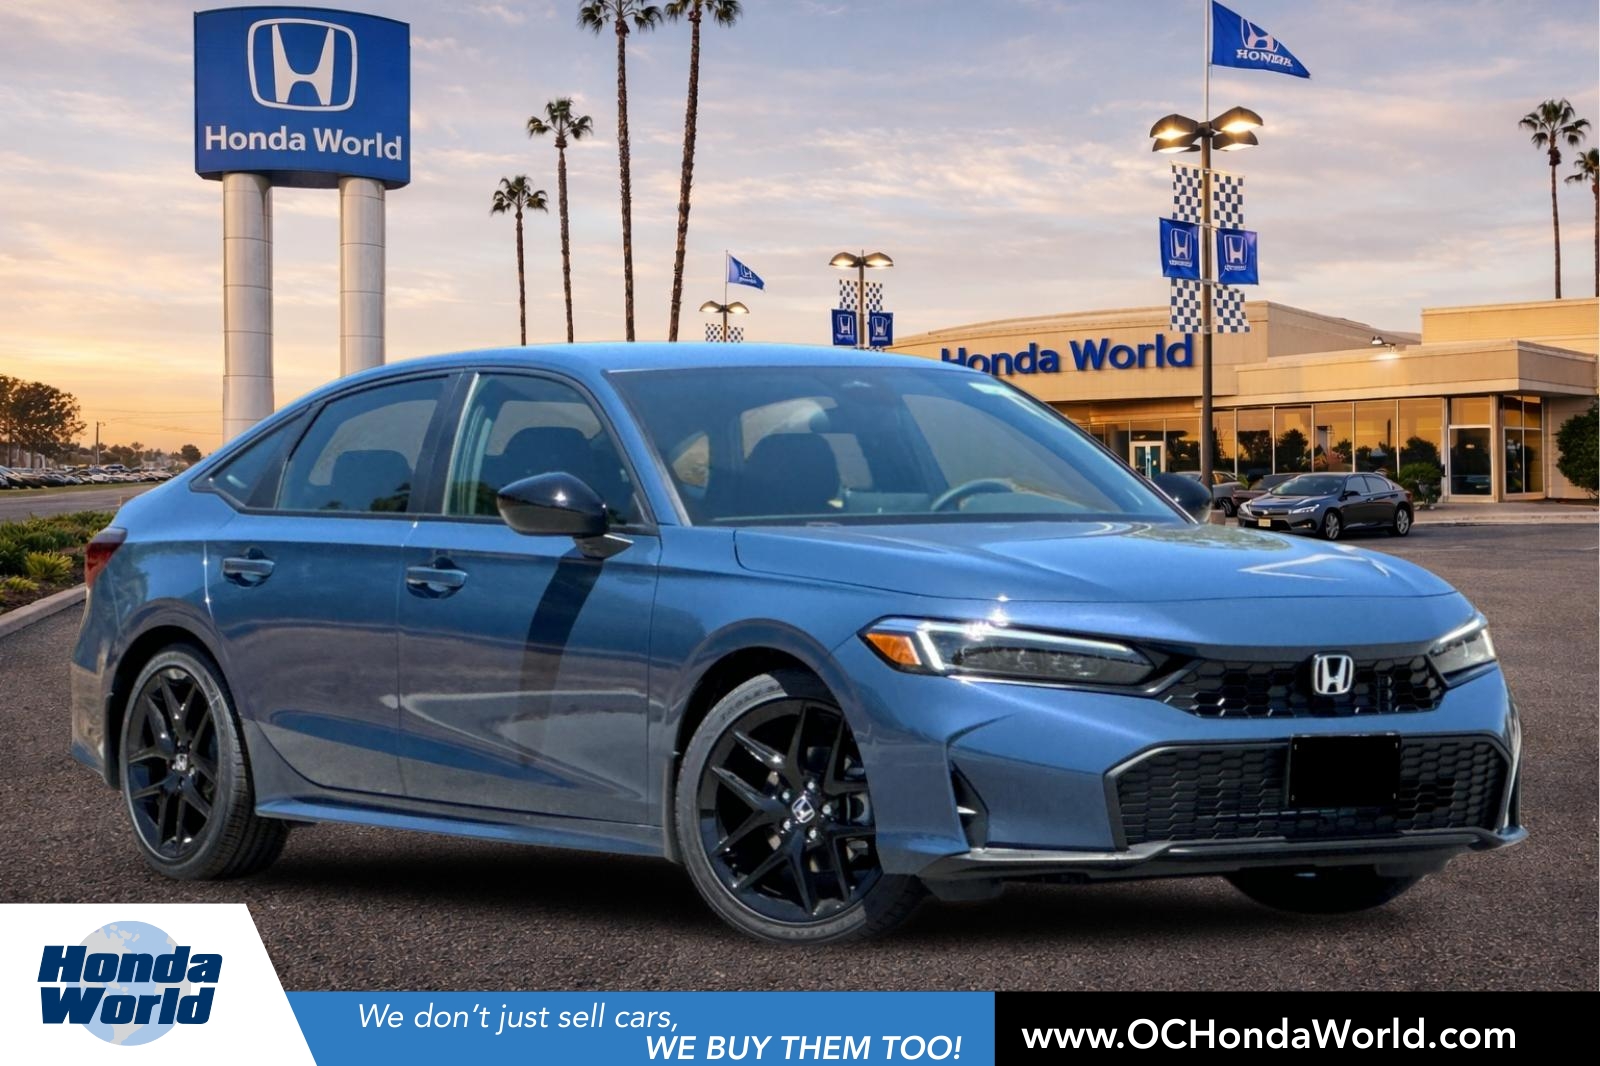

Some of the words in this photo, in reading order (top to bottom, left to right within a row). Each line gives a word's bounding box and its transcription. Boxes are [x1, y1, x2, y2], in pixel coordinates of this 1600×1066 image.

[205, 125, 306, 151] Honda
[313, 127, 402, 161] World
[1069, 333, 1194, 371] World
